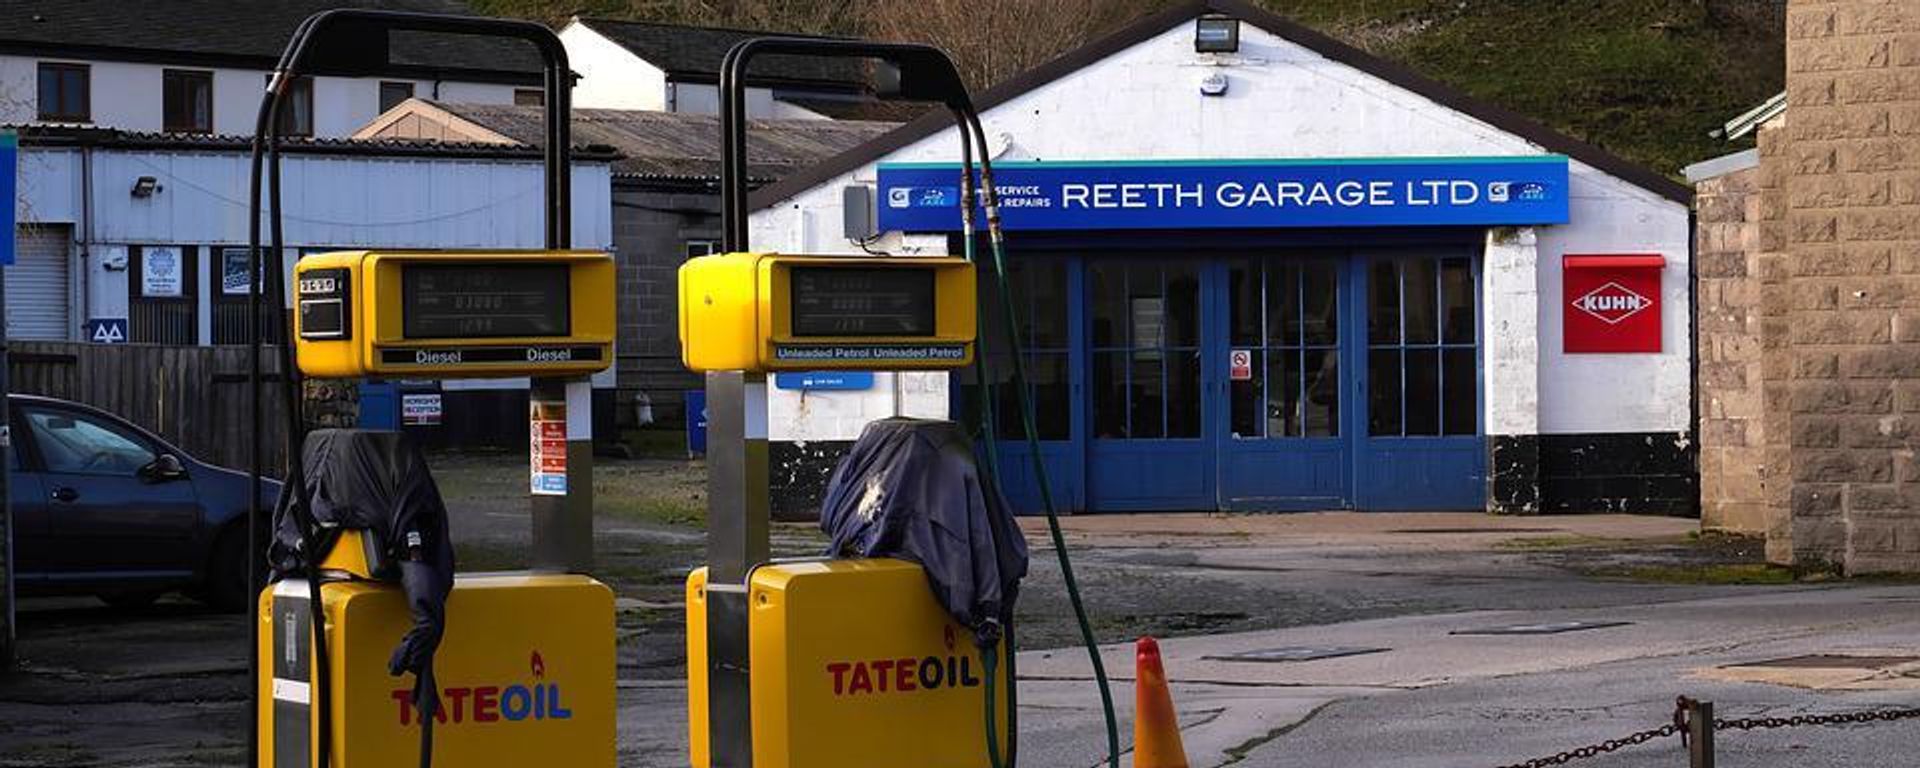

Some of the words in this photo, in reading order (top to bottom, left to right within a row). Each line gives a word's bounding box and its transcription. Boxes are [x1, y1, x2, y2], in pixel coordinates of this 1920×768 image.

[994, 185, 1040, 196] SERVICE
[1062, 183, 1204, 208] REETH
[1216, 181, 1395, 207] GARAGE
[1407, 180, 1480, 206] LTD
[1003, 197, 1052, 208] REPAIRS
[1583, 295, 1640, 310] KUHN
[415, 350, 462, 364] Diesel
[526, 347, 571, 362] Diesel
[777, 347, 833, 359] Unleaded
[835, 347, 870, 359] Petrol
[873, 346, 927, 359] Unleaded
[928, 346, 963, 358] Petrol
[827, 655, 979, 696] TATEOIL
